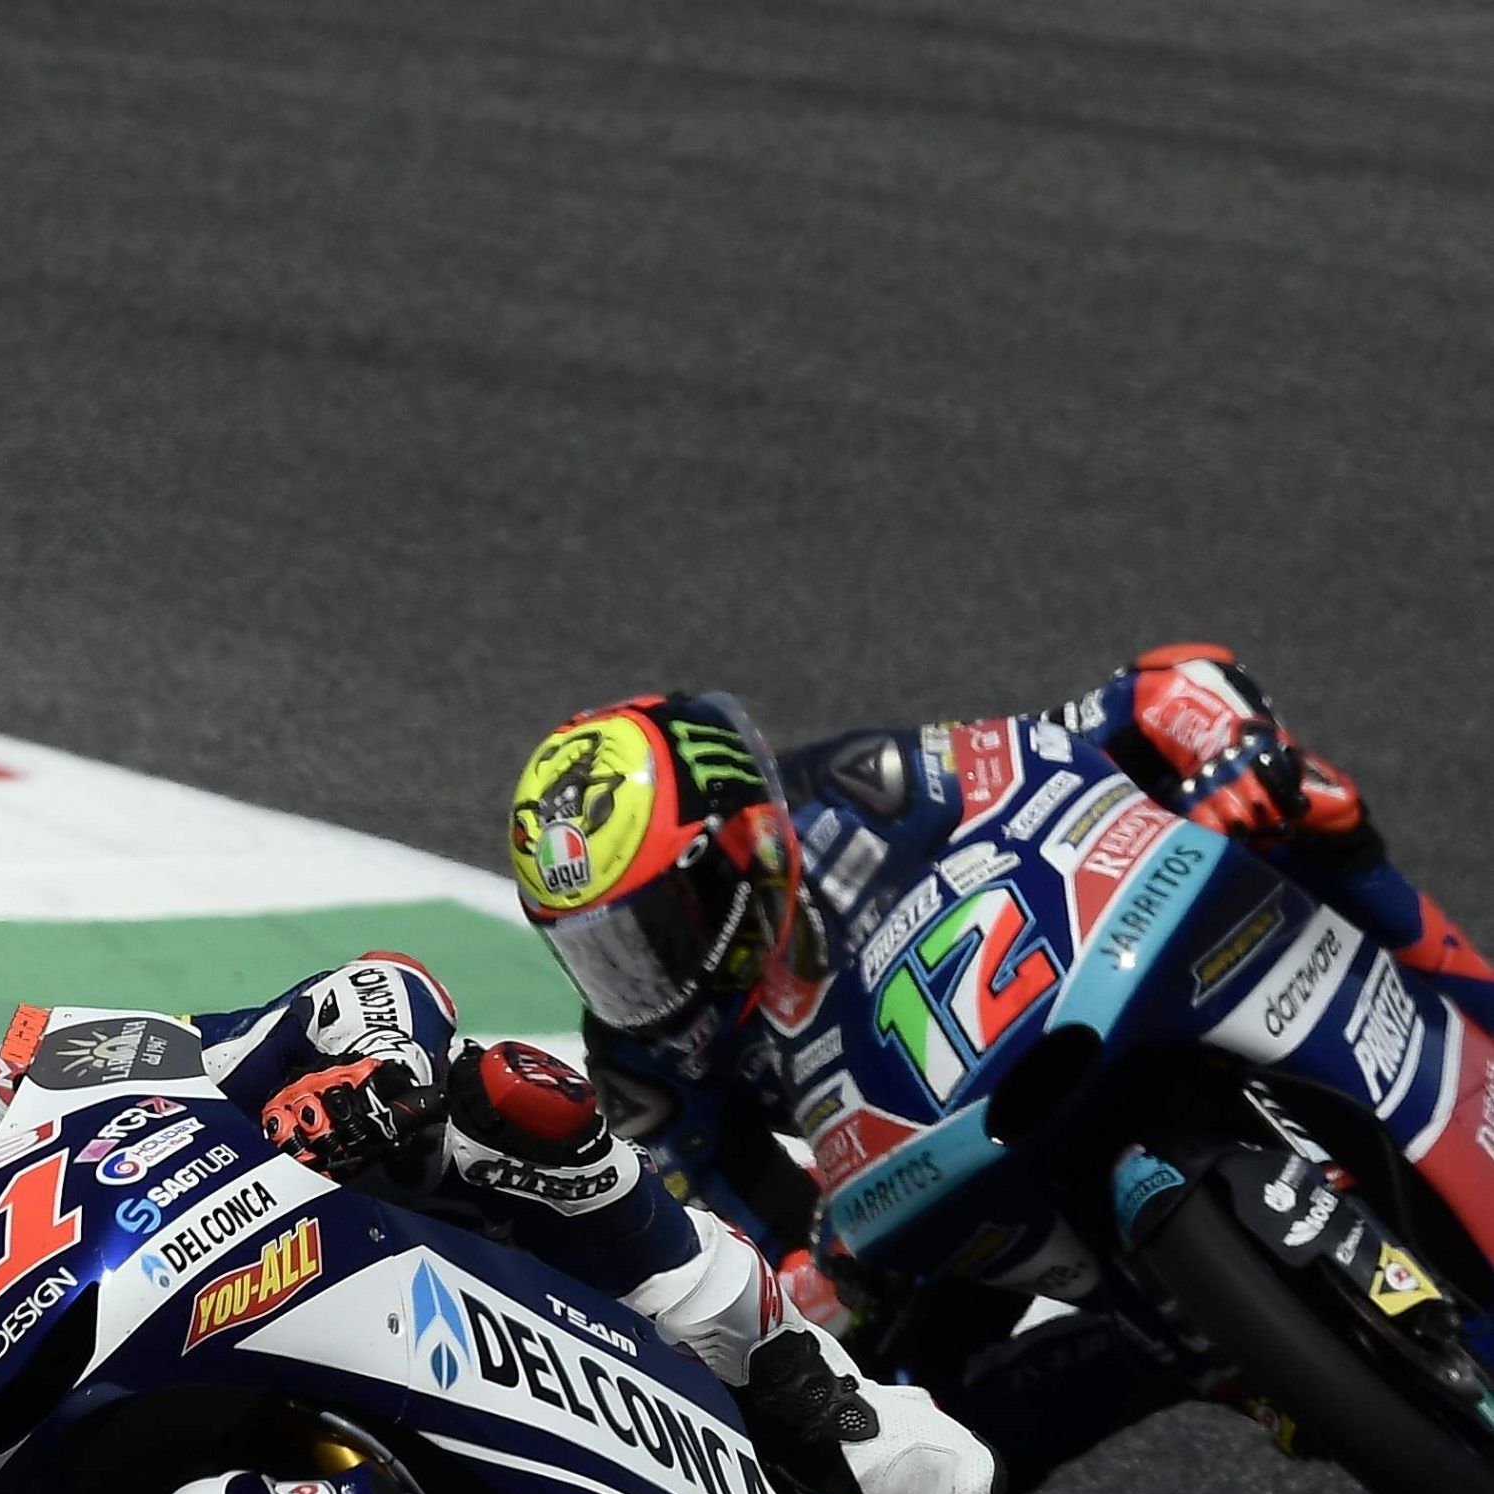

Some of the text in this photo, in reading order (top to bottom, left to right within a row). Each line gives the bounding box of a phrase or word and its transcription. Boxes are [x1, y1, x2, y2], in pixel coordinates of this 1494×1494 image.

[874, 878, 1066, 1117] 12
[147, 1143, 239, 1208] SAGTUBI
[198, 1220, 317, 1334] YOU-ALL
[546, 1293, 637, 1357] TEAM
